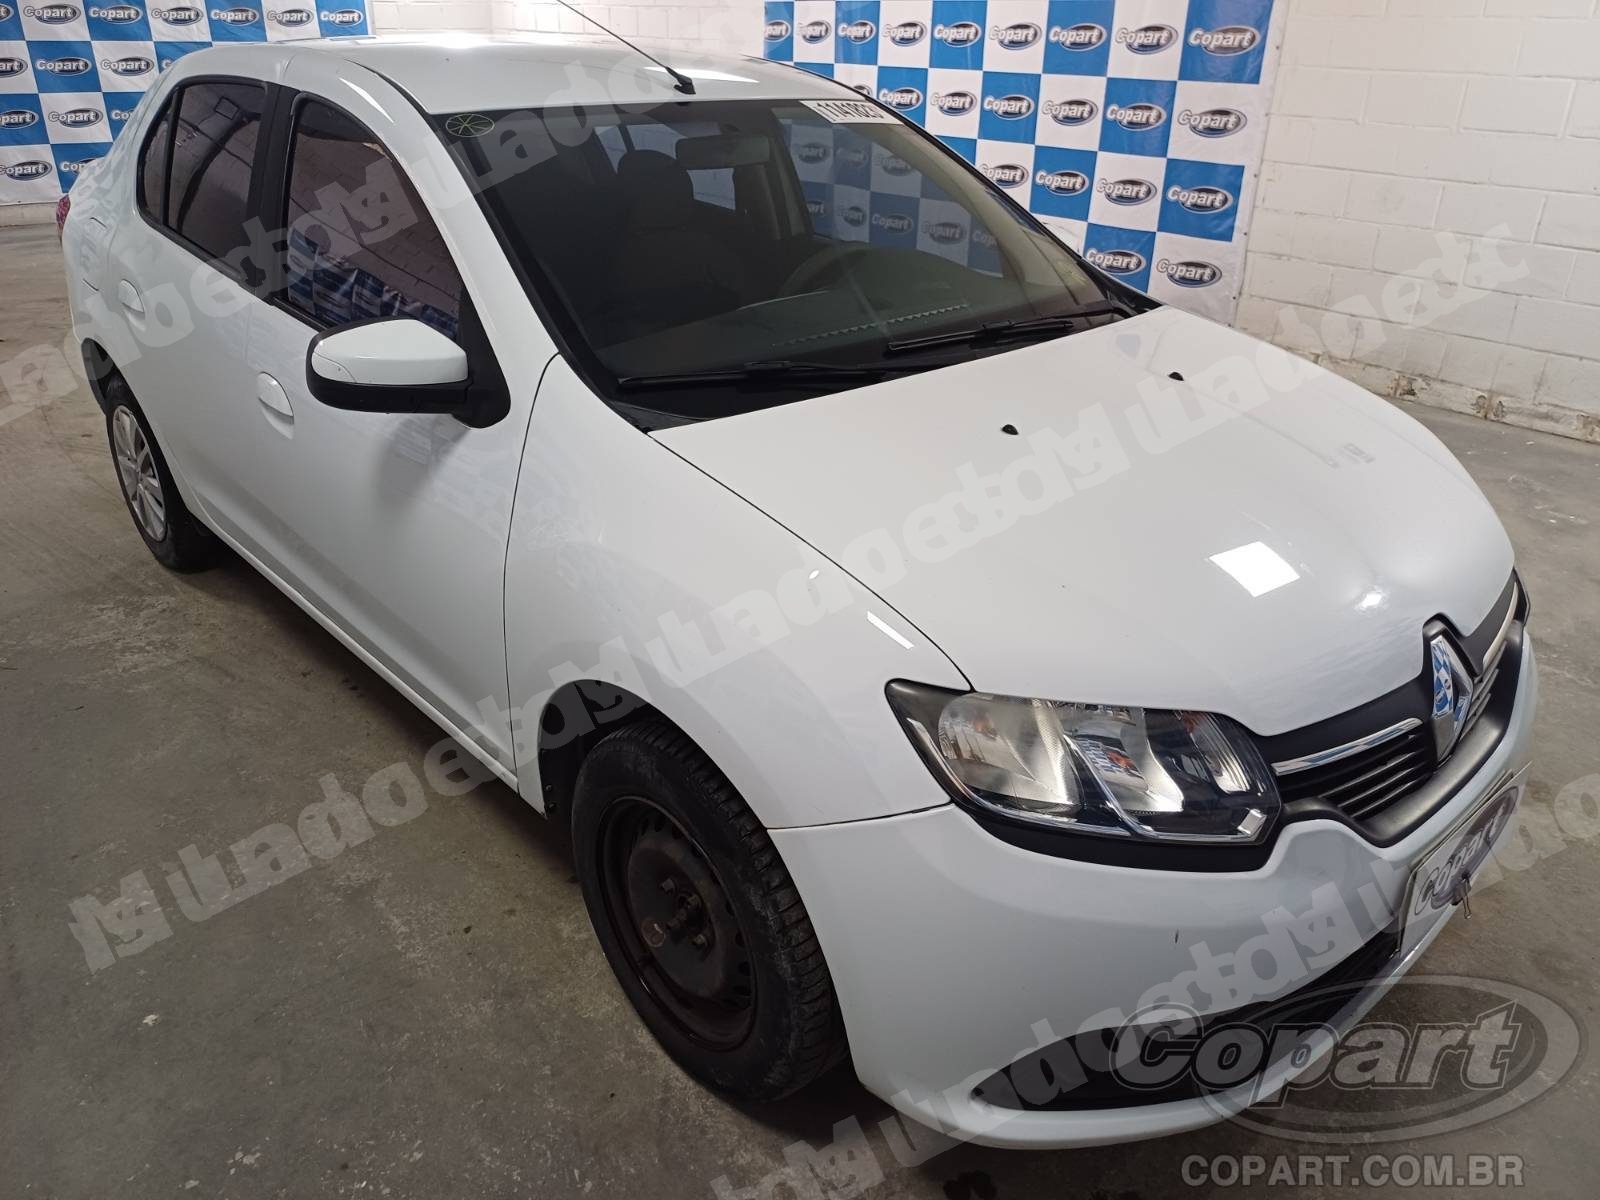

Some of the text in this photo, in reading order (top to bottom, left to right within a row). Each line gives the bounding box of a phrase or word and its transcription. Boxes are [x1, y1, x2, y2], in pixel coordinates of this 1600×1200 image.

[24, 6, 74, 20] Copart
[89, 8, 137, 21] Copart
[151, 8, 196, 22] Copart
[211, 9, 254, 22] Copart
[267, 11, 308, 23] Copart
[320, 11, 360, 23] Copart
[883, 24, 921, 42] Copart
[934, 24, 976, 43] Copart
[989, 26, 1034, 44] Copart
[1049, 27, 1098, 47] Copart
[1116, 28, 1171, 48] Copart
[1188, 30, 1252, 51] Copart
[36, 59, 85, 71] Copart
[101, 59, 147, 72] Copart
[879, 88, 918, 106] Copart
[931, 93, 971, 110] Copart
[984, 96, 1028, 115] Copart
[48, 111, 95, 123] Copart
[1042, 100, 1089, 120] Copart
[1106, 104, 1157, 125] Copart
[1178, 110, 1238, 132] Copart
[1035, 170, 1083, 190] Copart
[1097, 178, 1147, 200] Copart
[1167, 186, 1224, 209] Copart
[872, 213, 909, 231] Copart
[1086, 248, 1138, 271] Copart
[1157, 258, 1213, 282] Copart
[1415, 799, 1507, 915] Copart
